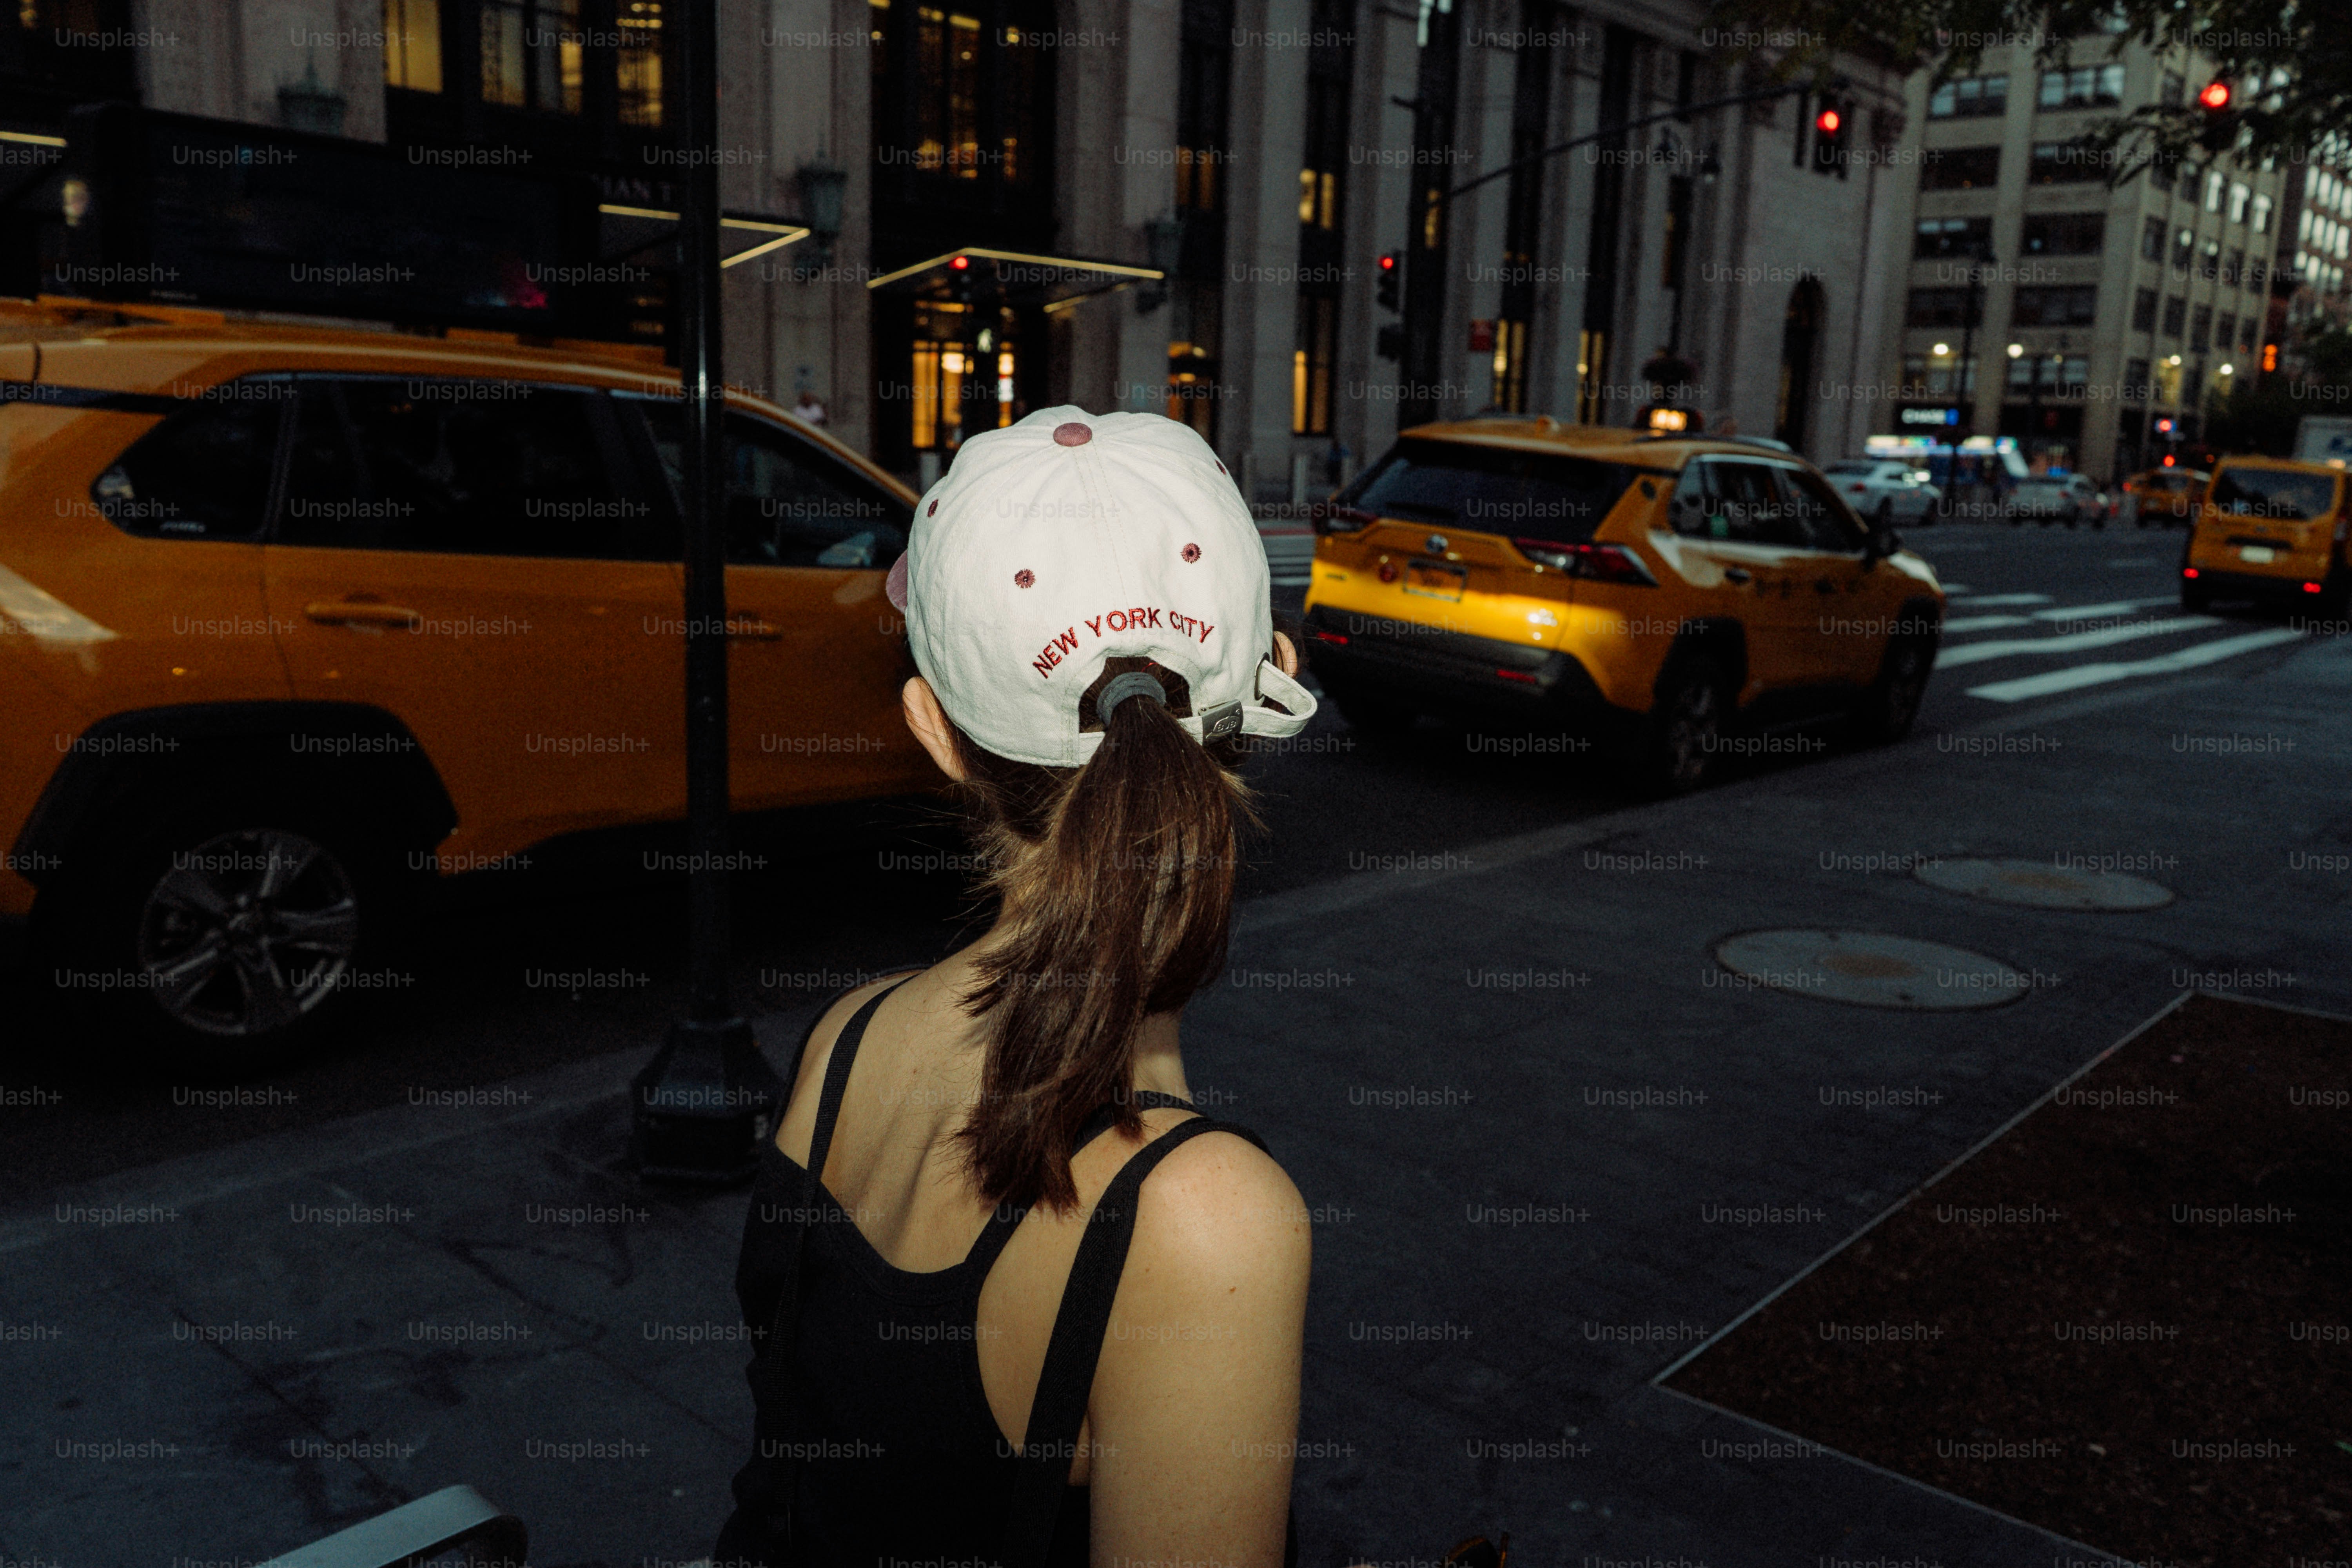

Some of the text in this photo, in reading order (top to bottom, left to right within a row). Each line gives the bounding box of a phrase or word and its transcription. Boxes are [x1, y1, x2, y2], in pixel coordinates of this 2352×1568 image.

[1032, 626, 1079, 679] NEW
[1084, 607, 1162, 637] YORK
[1169, 610, 1214, 643] CITY
